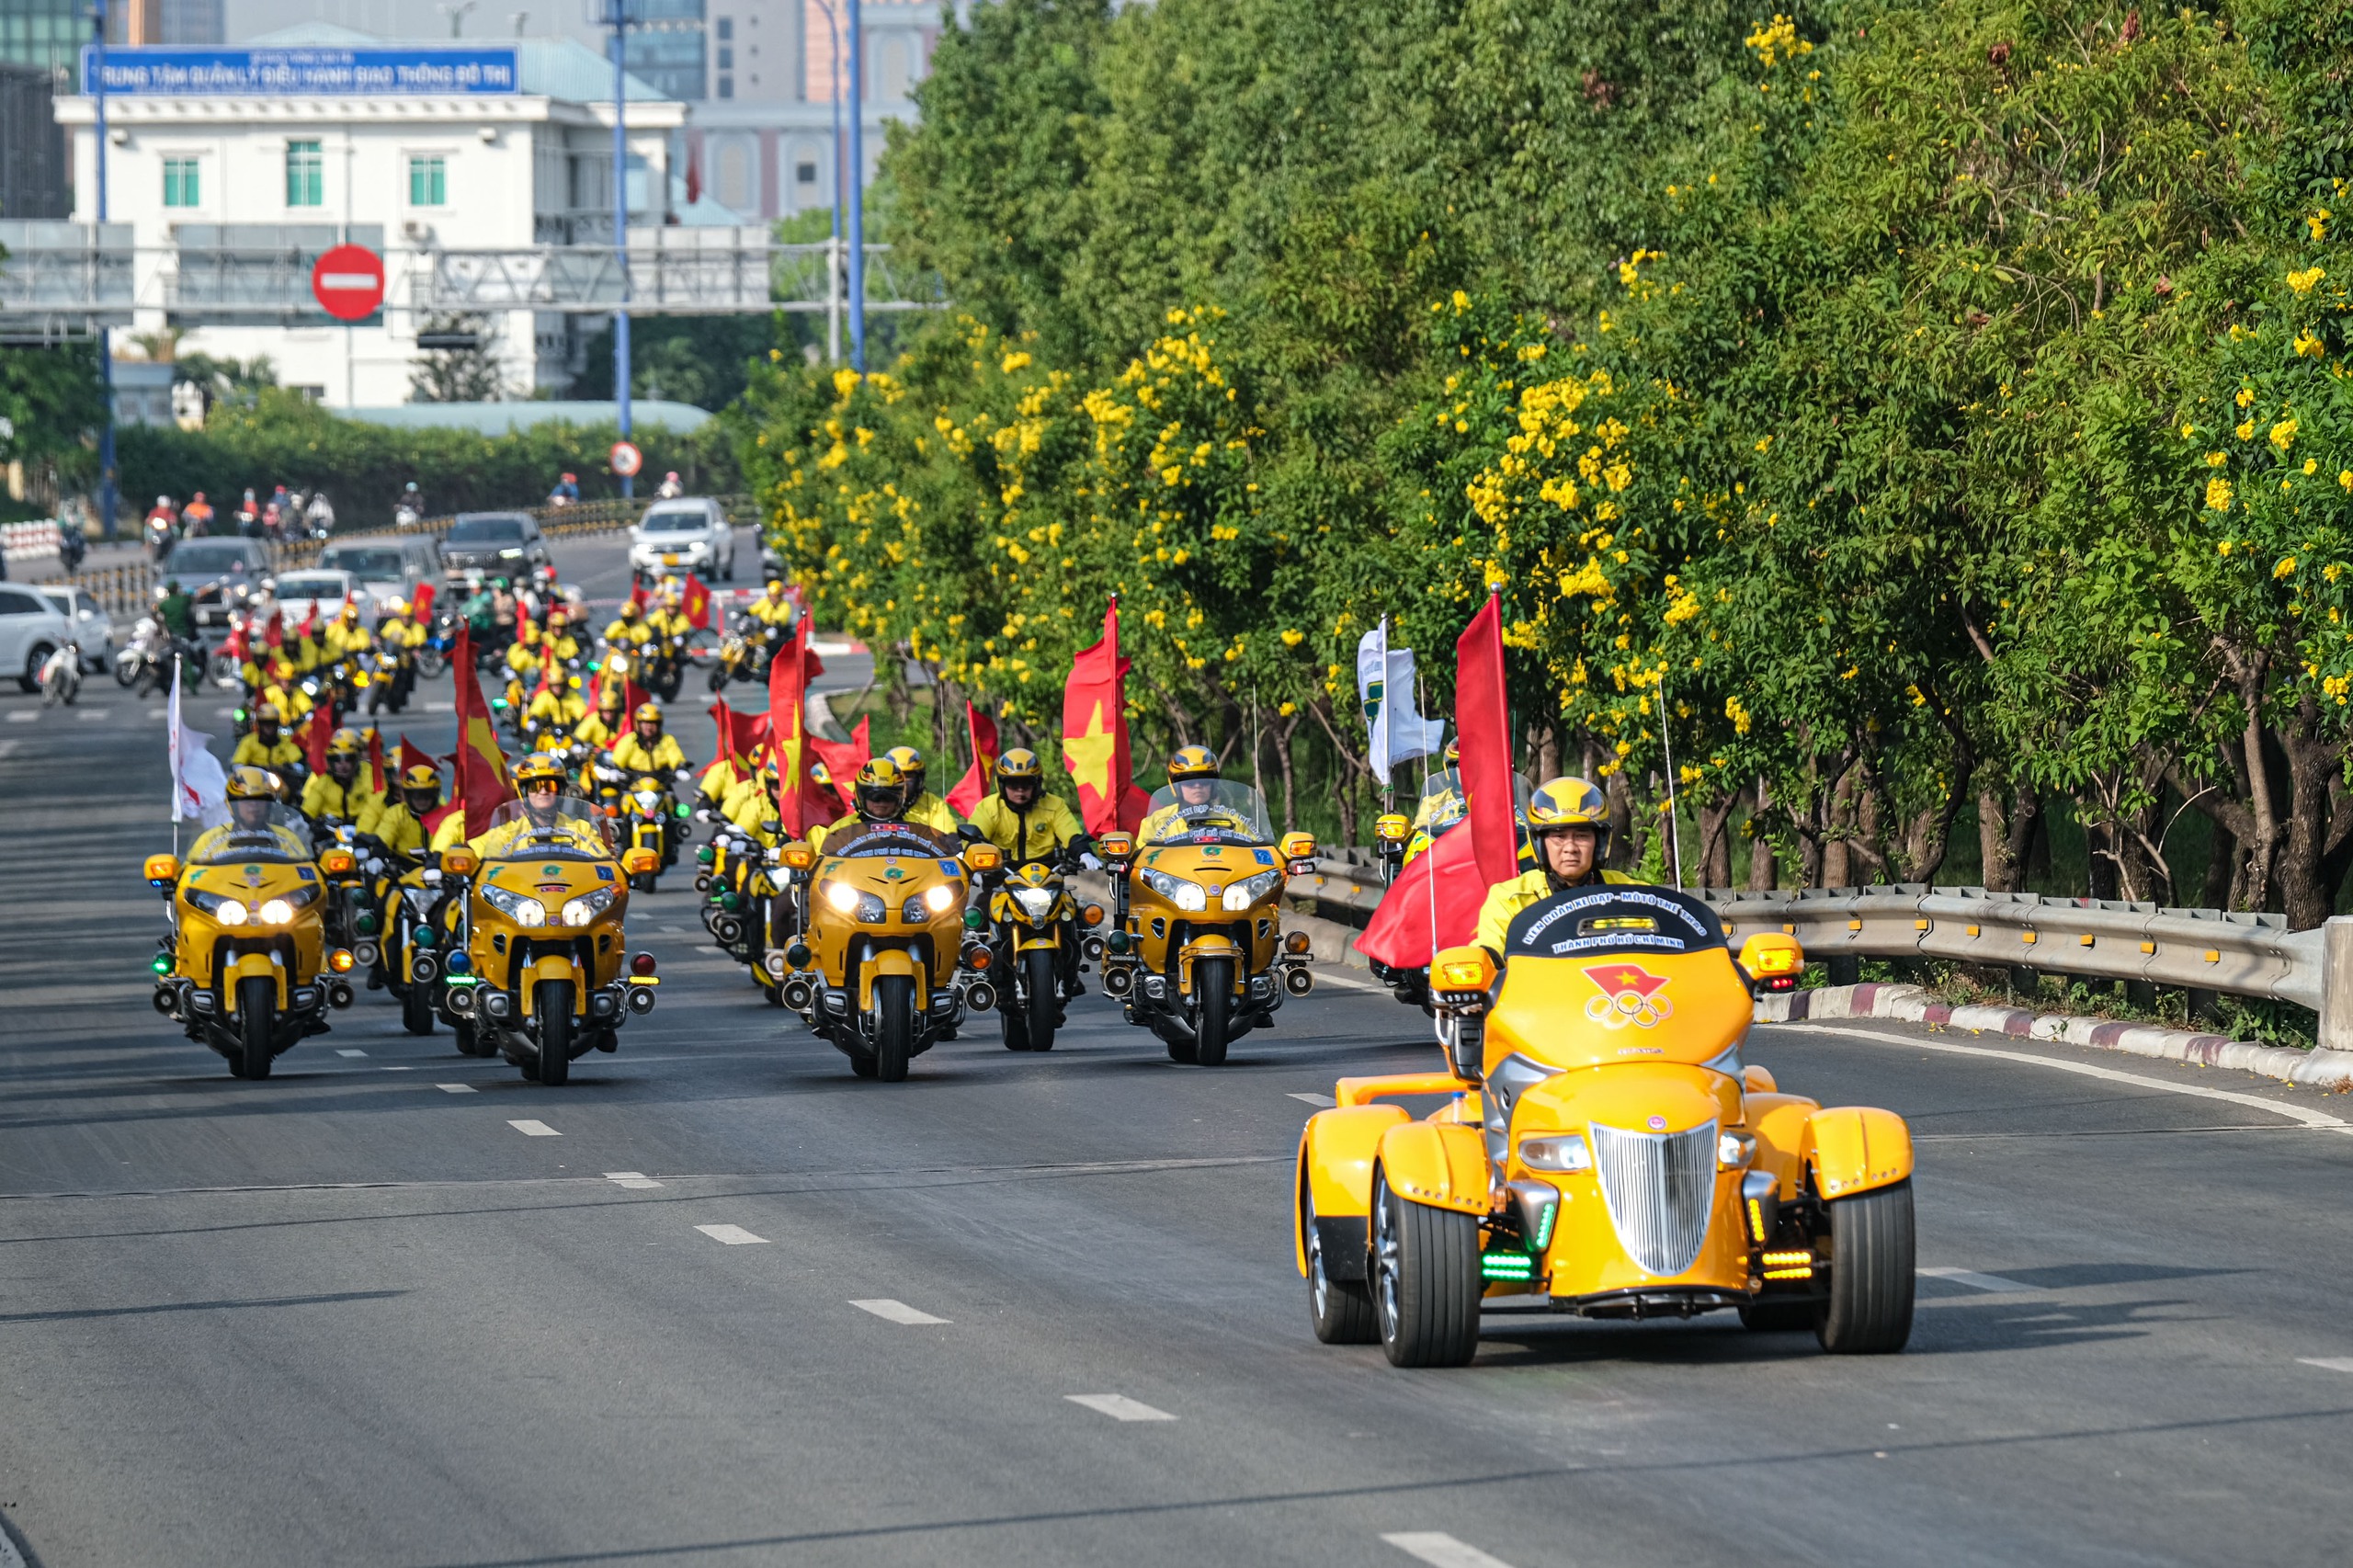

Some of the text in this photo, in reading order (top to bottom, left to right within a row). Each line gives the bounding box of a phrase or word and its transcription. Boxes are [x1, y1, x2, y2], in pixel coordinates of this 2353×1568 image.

[1541, 902, 1575, 926] ĐOÀN
[1573, 896, 1590, 910] XE
[1588, 892, 1614, 906] ĐẠP
[1552, 932, 1685, 955] THÀNH PHỐ HỒ CHÍ MINH
